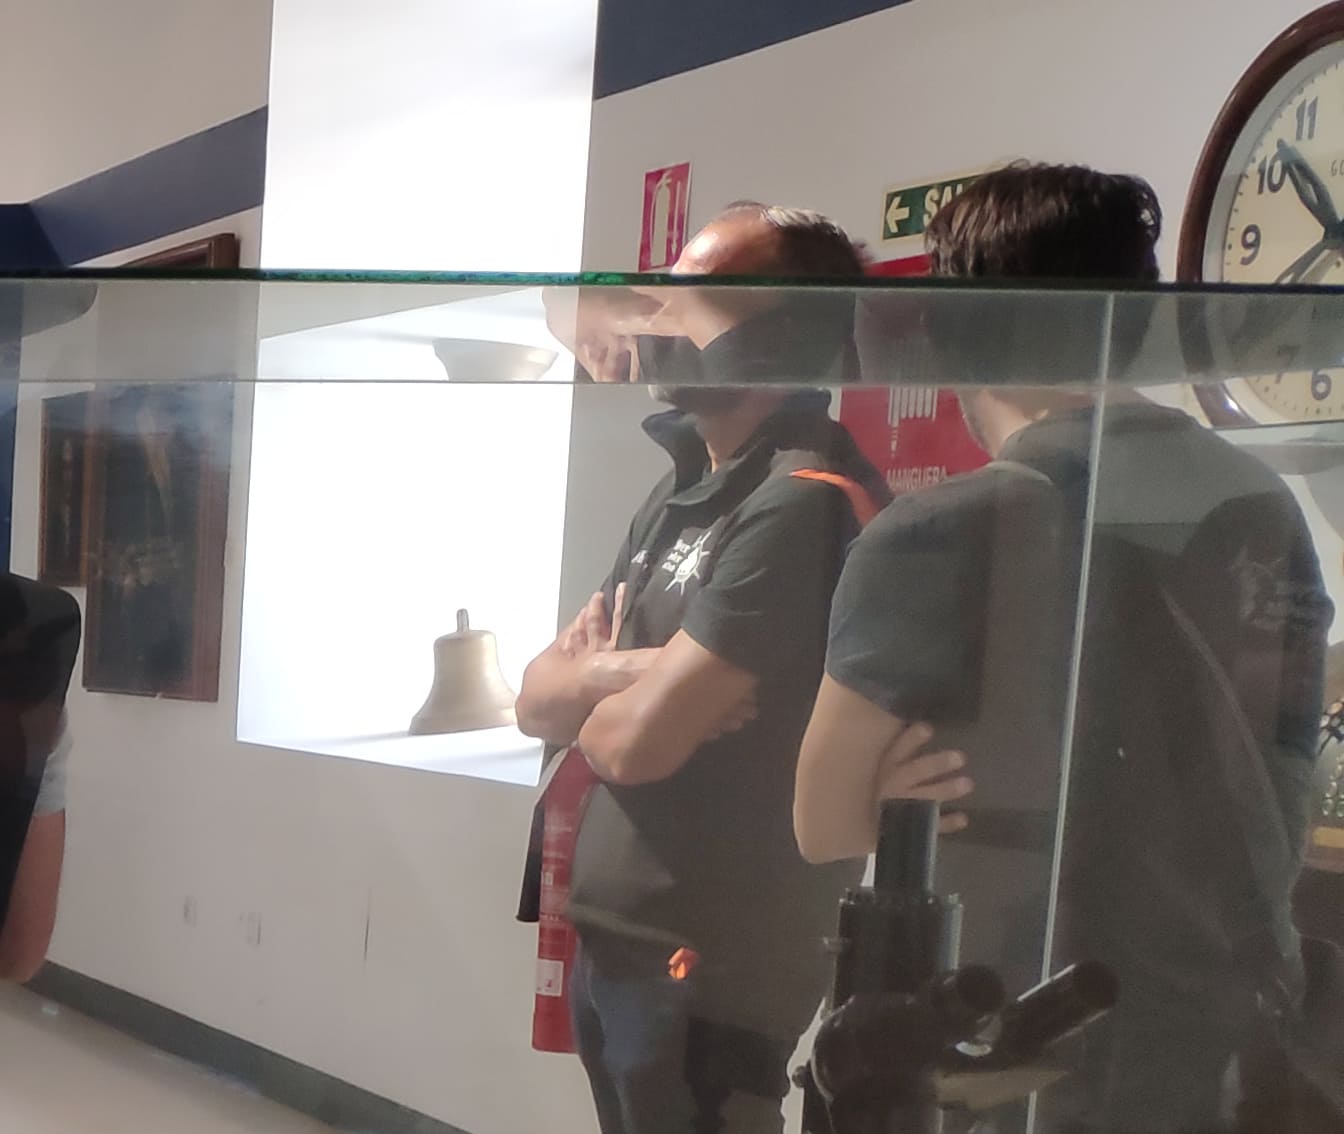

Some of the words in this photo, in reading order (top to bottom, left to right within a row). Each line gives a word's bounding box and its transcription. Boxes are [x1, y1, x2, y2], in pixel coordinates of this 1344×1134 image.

[1295, 96, 1319, 141] 11
[1257, 153, 1288, 195] 10
[1240, 224, 1262, 266] 9
